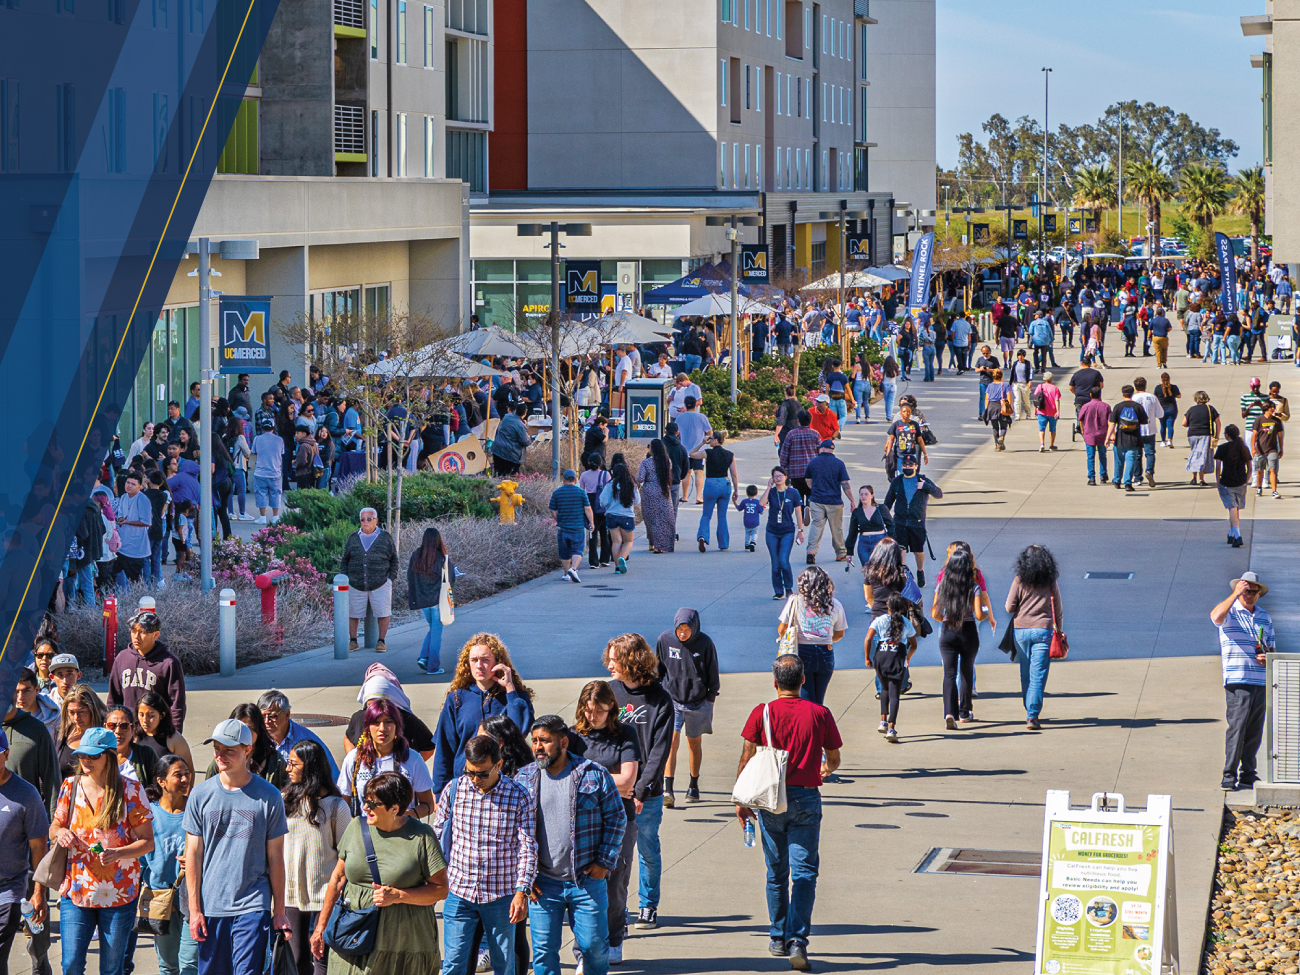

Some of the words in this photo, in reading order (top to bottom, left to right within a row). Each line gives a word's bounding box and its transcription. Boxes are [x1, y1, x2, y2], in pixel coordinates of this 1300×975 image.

[920, 238, 928, 262] ROCK
[743, 251, 766, 270] M
[567, 270, 598, 294] M
[916, 264, 926, 303] SENTINEL
[522, 304, 550, 313] APIRC
[567, 295, 598, 303] UCMERCED
[223, 311, 266, 346] M
[224, 348, 266, 359] UCMERCED
[632, 403, 657, 424] M
[746, 506, 755, 514] 35
[880, 643, 899, 652] NY
[121, 667, 157, 691] GAP
[1071, 831, 1134, 848] CALFRESH
